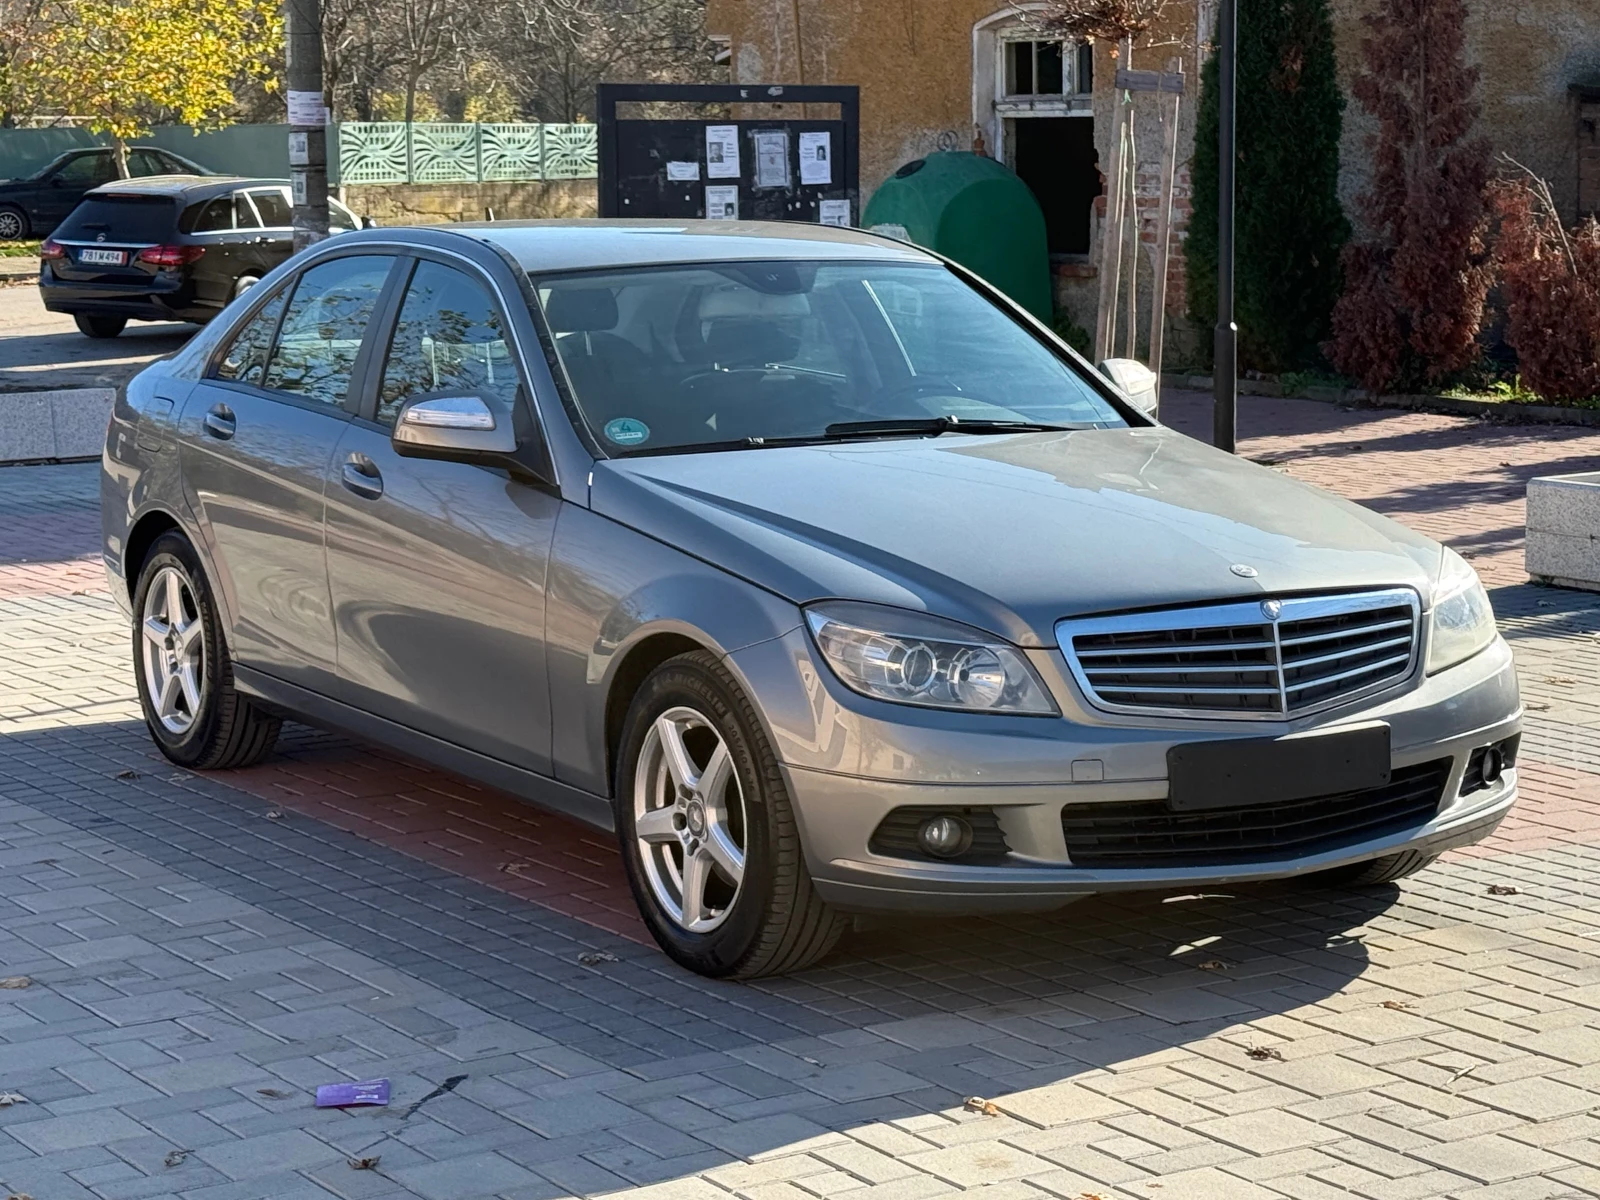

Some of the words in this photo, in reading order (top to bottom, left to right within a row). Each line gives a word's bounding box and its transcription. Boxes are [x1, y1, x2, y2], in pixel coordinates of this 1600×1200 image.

[621, 421, 631, 432] 4
[201, 601, 213, 679] MICHELIN
[674, 673, 727, 717] MICHELIN
